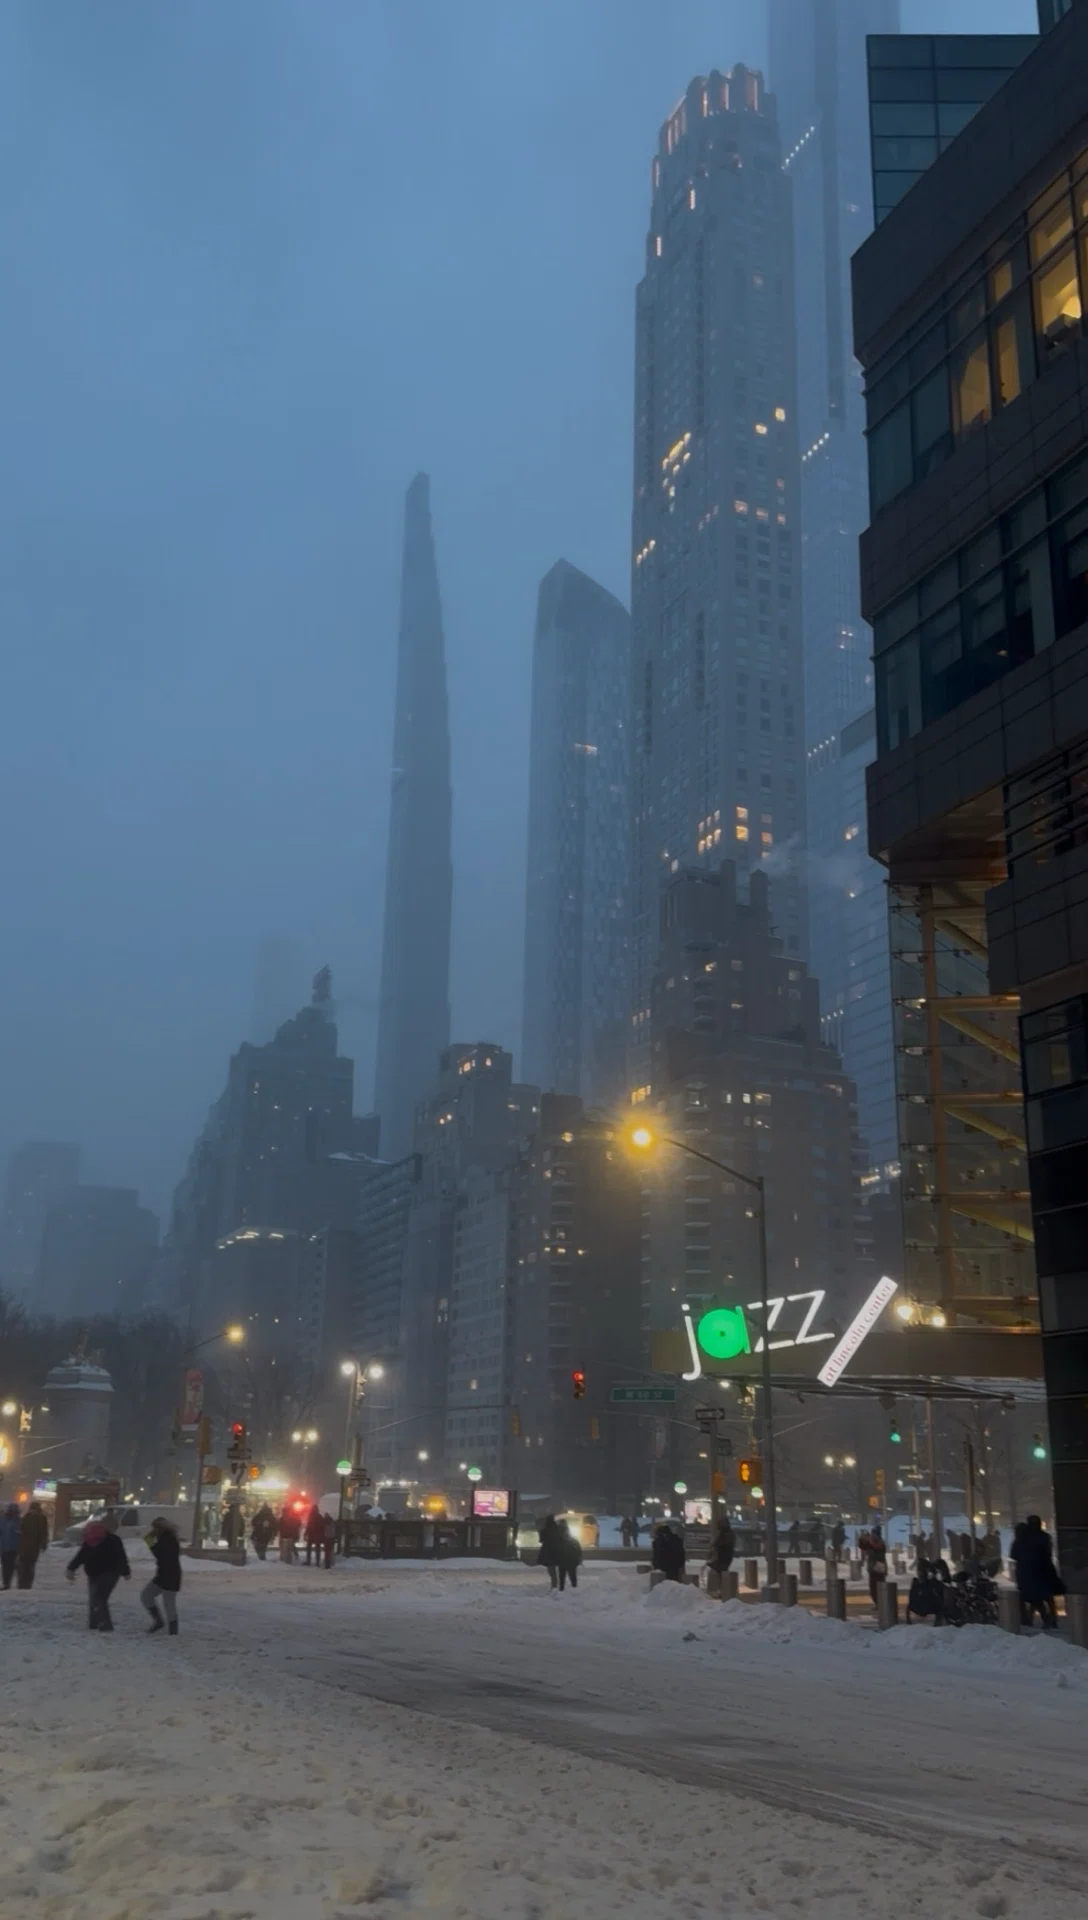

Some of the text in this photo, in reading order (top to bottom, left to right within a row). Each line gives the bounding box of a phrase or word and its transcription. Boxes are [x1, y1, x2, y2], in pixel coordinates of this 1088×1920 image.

[681, 1290, 835, 1381] jazz
[825, 1283, 893, 1383] at lincoln center
